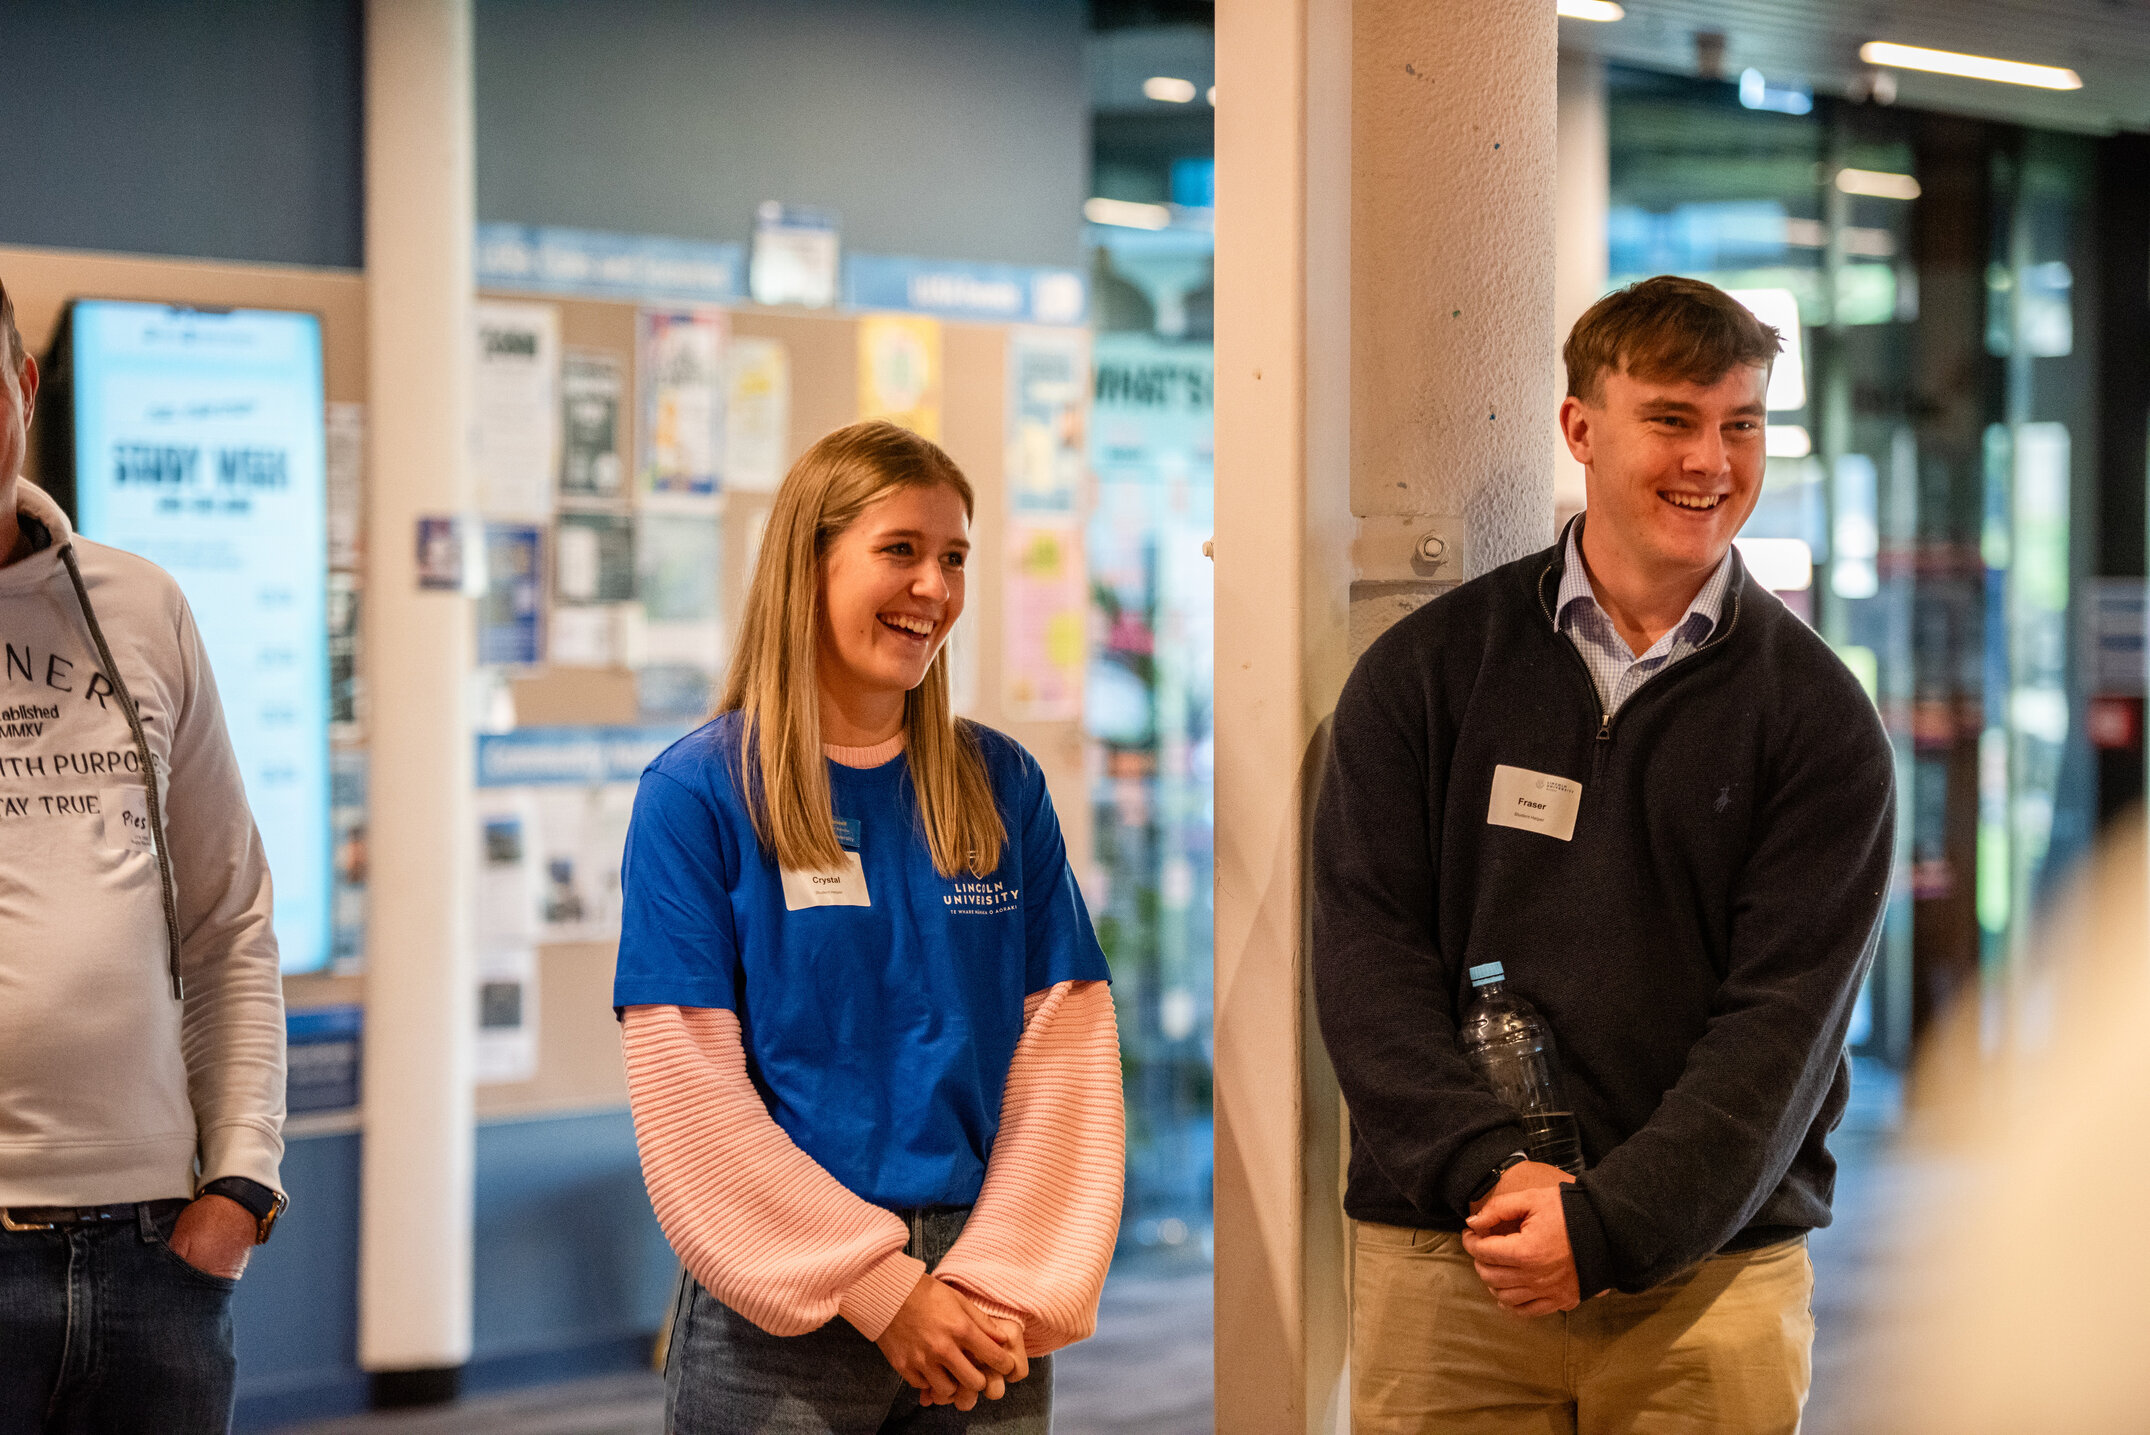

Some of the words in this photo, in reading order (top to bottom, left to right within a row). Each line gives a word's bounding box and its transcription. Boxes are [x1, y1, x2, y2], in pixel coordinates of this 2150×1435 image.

[113, 440, 200, 488] STUDY
[38, 795, 101, 815] TRUE
[1518, 797, 1547, 810] Fraser
[812, 876, 841, 885] Crystal
[954, 881, 1004, 893] LINCOLN
[943, 889, 1019, 905] UNIVERSITY
